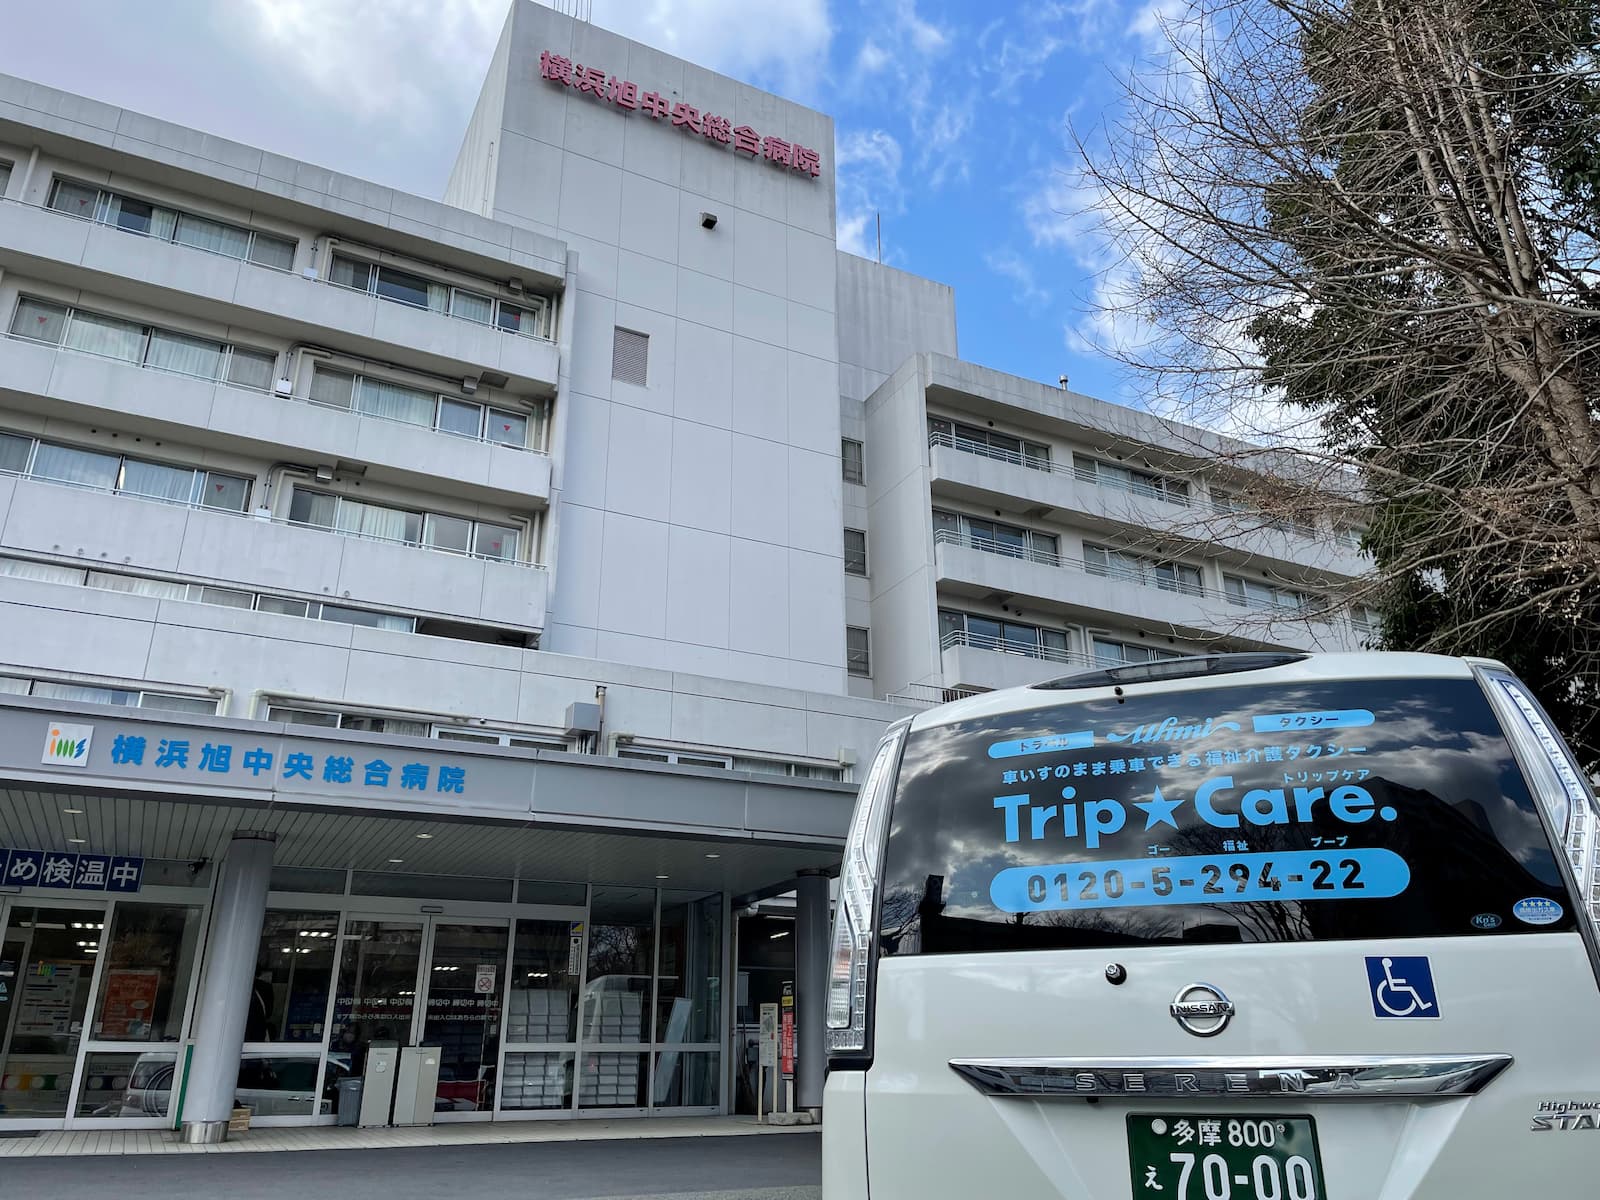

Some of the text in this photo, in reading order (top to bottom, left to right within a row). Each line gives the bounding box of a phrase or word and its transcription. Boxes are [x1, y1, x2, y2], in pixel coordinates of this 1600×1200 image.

[540, 50, 821, 177] 横浜旭中央総合病院
[1279, 713, 1340, 728] タクシー
[111, 734, 466, 793] 横浜旭中央総合病院
[1002, 742, 1368, 785] 車いすのまま乗車できる福祉介護タクシー
[1282, 768, 1371, 784] トリップケア
[994, 776, 1398, 848] Trip Care.
[1222, 839, 1249, 853] 福祉
[0, 857, 138, 887] め検温中
[1027, 858, 1366, 904] 0120-5-294-22
[1176, 1003, 1229, 1015] NISSAN
[1074, 1072, 1361, 1092] SERENA
[1171, 1119, 1276, 1148] 多摩 800
[1531, 1114, 1600, 1131] STA
[1144, 1152, 1316, 1200] え 70-00
